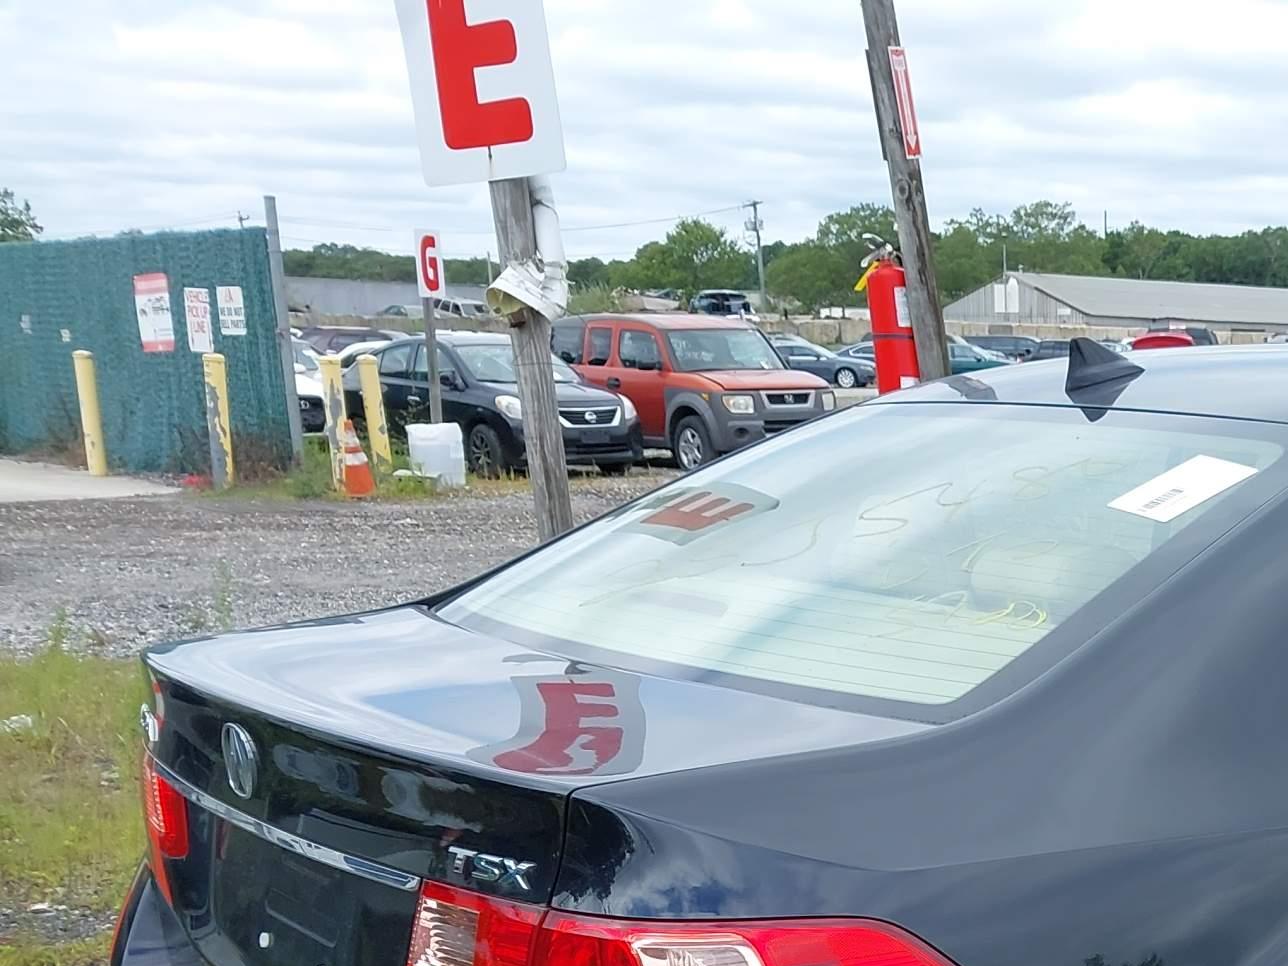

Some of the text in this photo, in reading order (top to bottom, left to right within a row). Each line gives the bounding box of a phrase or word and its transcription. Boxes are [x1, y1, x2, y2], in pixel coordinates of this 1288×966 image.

[426, 0, 534, 150] E
[420, 234, 439, 291] G
[448, 846, 537, 890] TSX
